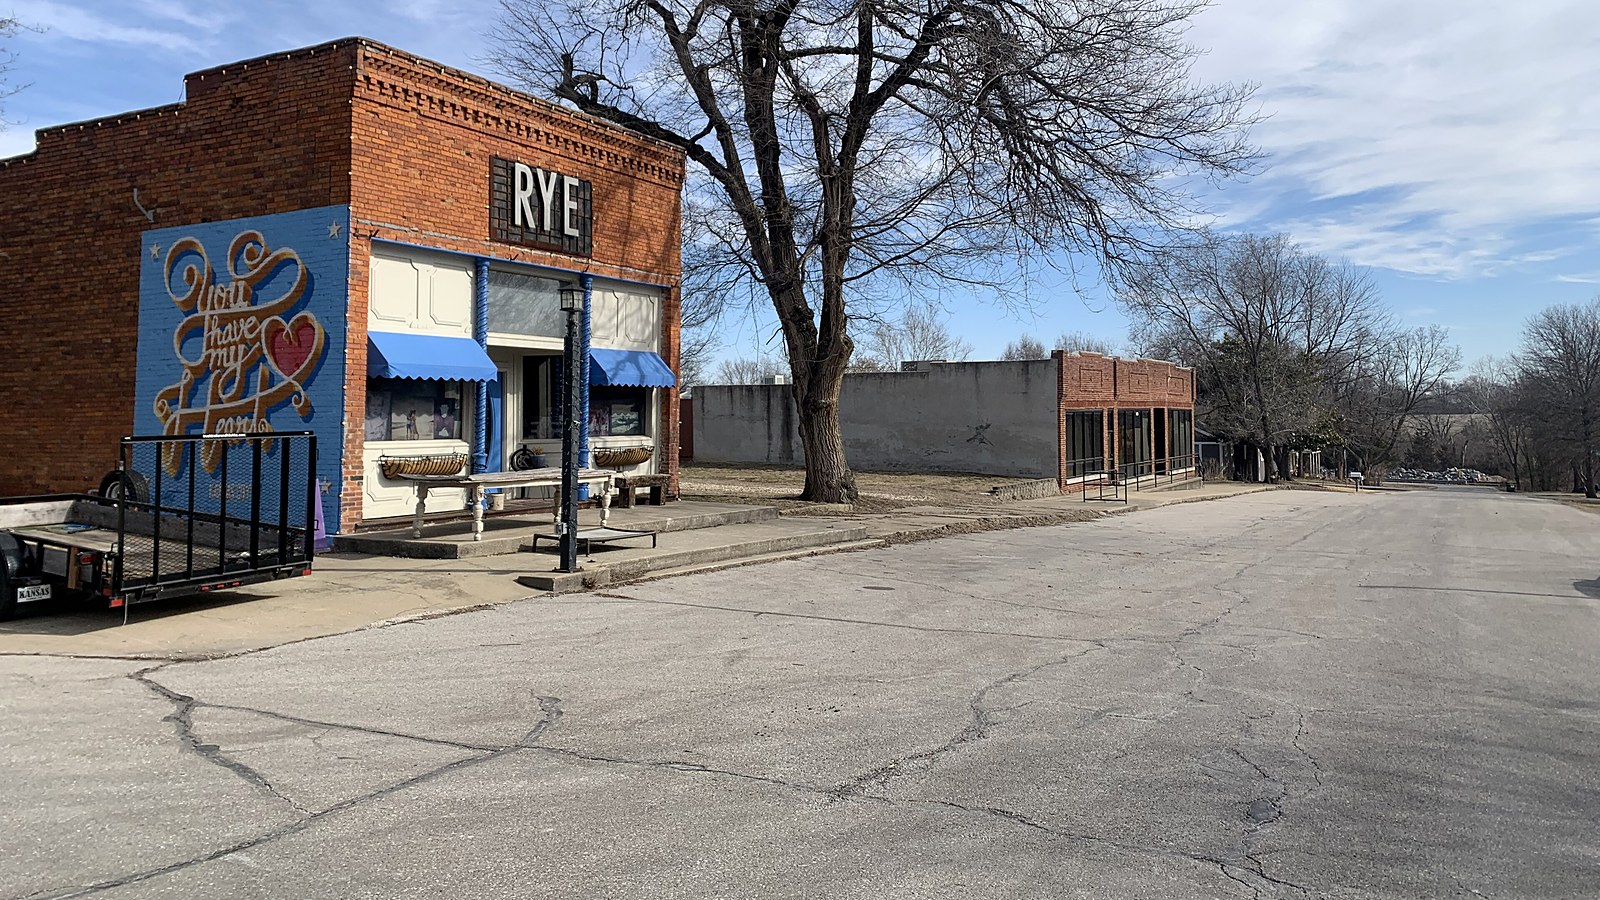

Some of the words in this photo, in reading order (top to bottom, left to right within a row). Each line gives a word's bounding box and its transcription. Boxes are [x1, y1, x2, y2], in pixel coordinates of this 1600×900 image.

[514, 162, 579, 237] RYE
[206, 314, 264, 347] have
[203, 342, 262, 400] my
[19, 587, 50, 599] KANSAS
